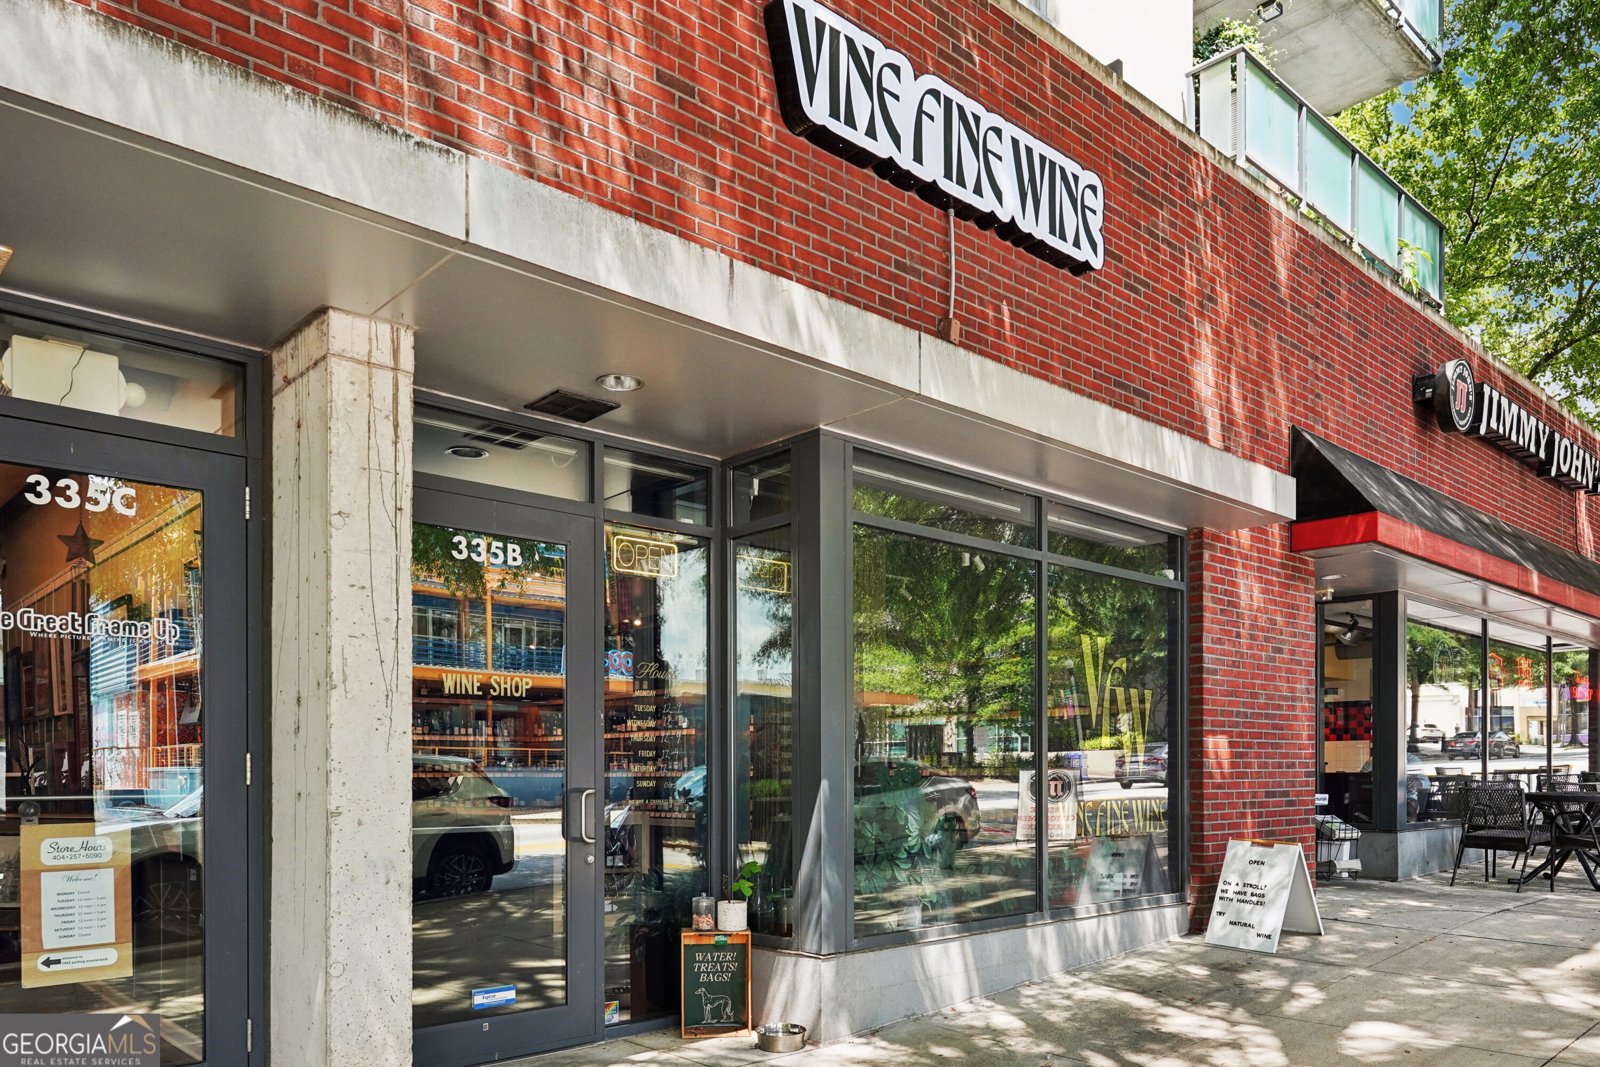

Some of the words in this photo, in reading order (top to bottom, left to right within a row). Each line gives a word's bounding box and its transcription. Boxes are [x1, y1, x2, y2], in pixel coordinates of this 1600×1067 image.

[793, 2, 902, 154] VINE
[912, 88, 1003, 209] FINE
[1010, 135, 1098, 260] WINE
[1480, 383, 1550, 461] JIMMY
[1551, 431, 1600, 494] JOHN'
[24, 474, 137, 516] 335C
[451, 535, 523, 567] 335B
[618, 542, 674, 575] OPEN
[17, 608, 83, 634] Great
[85, 613, 151, 638] Frame
[154, 618, 180, 645] Up
[442, 673, 483, 695] WINE
[490, 675, 532, 697] SHOP
[634, 704, 656, 712] TUESDAY
[627, 719, 656, 727] WEDNESDAY
[631, 735, 656, 743] THURSDAY
[631, 765, 656, 773] SATURDAY
[636, 780, 656, 788] SUNDAY
[1096, 800, 1130, 837] FINE
[1132, 800, 1169, 833] WINE
[47, 841, 75, 854] Store
[79, 840, 107, 852] Hours
[1248, 859, 1266, 867] OPEN
[1250, 891, 1266, 899] BAGS
[1229, 920, 1255, 929] NATURAL
[1256, 932, 1272, 940] WINE
[695, 952, 737, 962] WATER!
[693, 962, 738, 972] TREATS!
[699, 972, 732, 982] BAGS!
